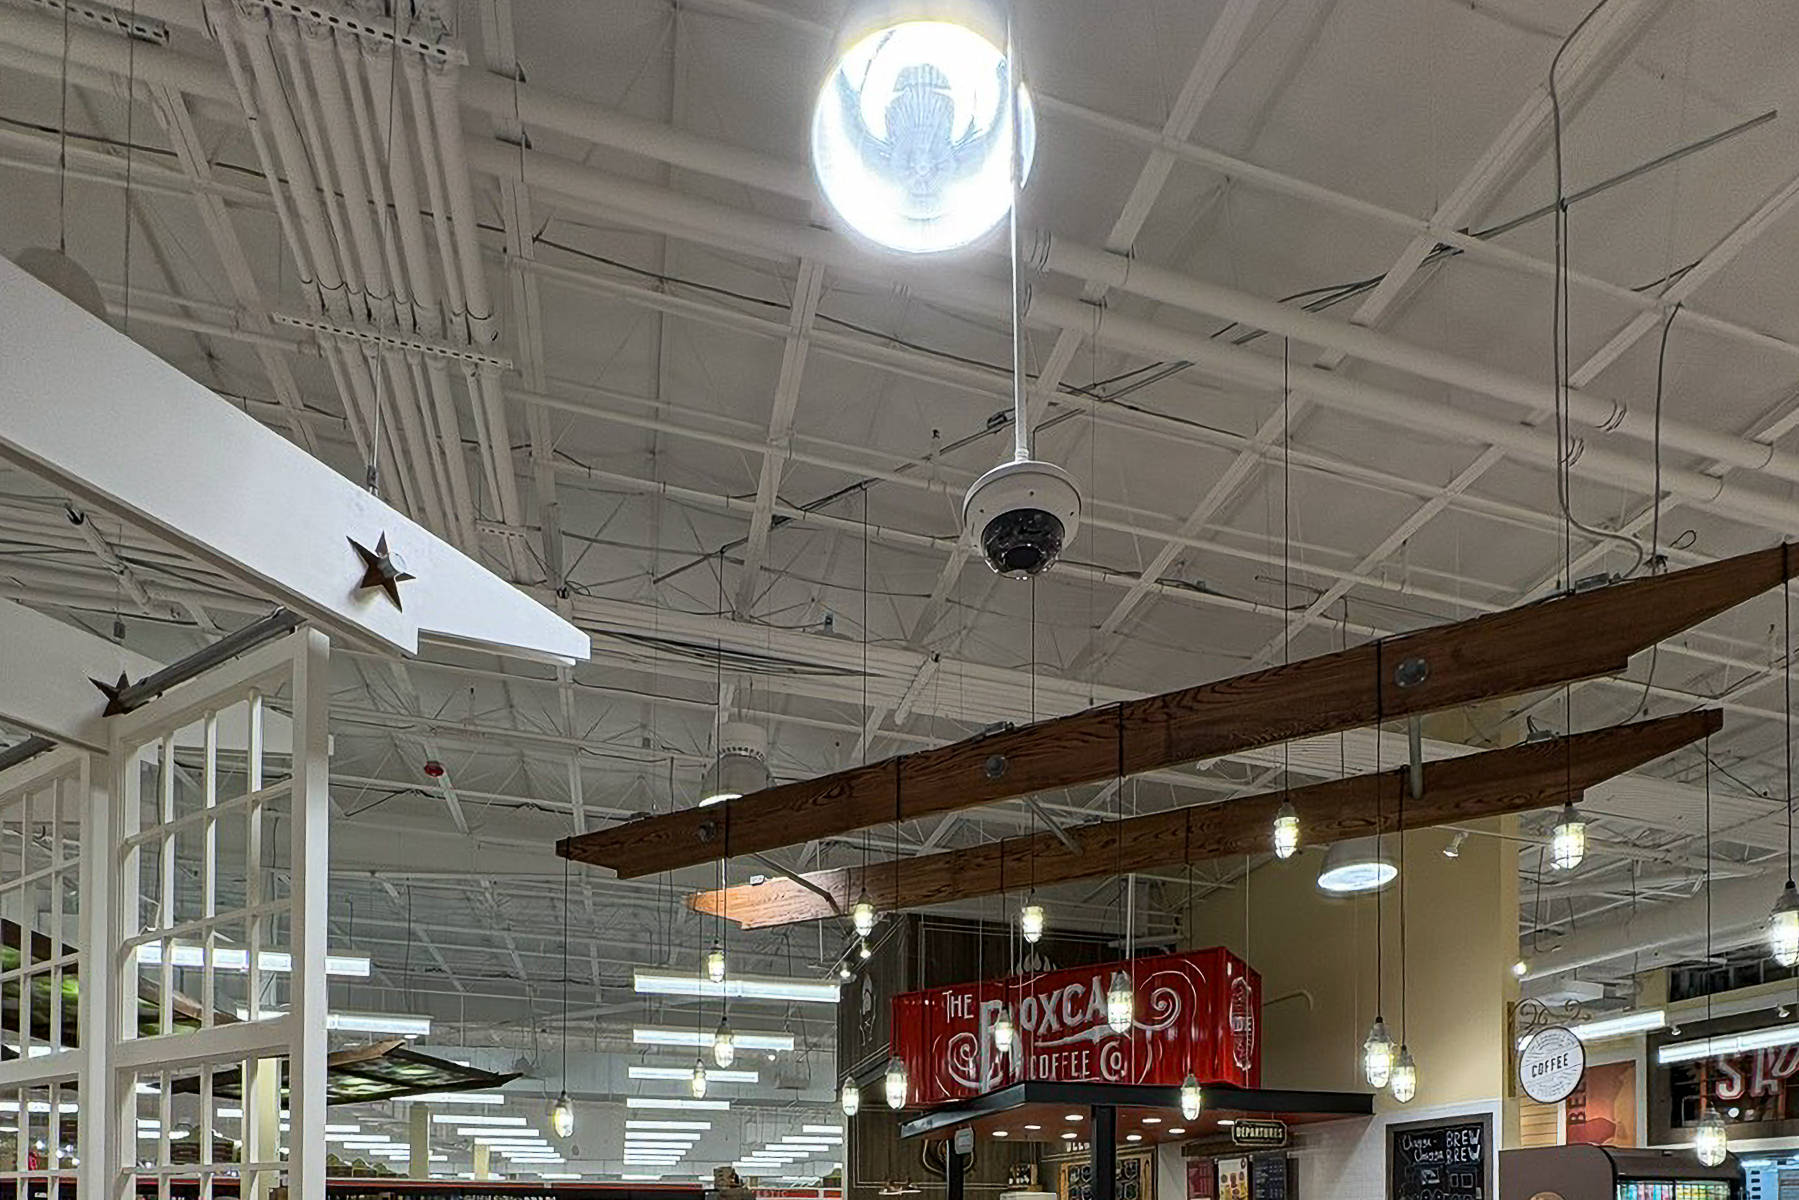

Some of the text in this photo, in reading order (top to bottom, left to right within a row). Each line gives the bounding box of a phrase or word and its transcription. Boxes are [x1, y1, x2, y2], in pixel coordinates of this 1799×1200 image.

[942, 990, 975, 1024] THE
[979, 968, 1134, 1091] BOXCA
[1031, 1050, 1091, 1080] COFFEE
[1531, 1052, 1569, 1078] COFFEE
[1235, 1126, 1284, 1138] DEPARTURES
[1445, 1128, 1480, 1148] BREW
[1445, 1144, 1481, 1166] BREW
